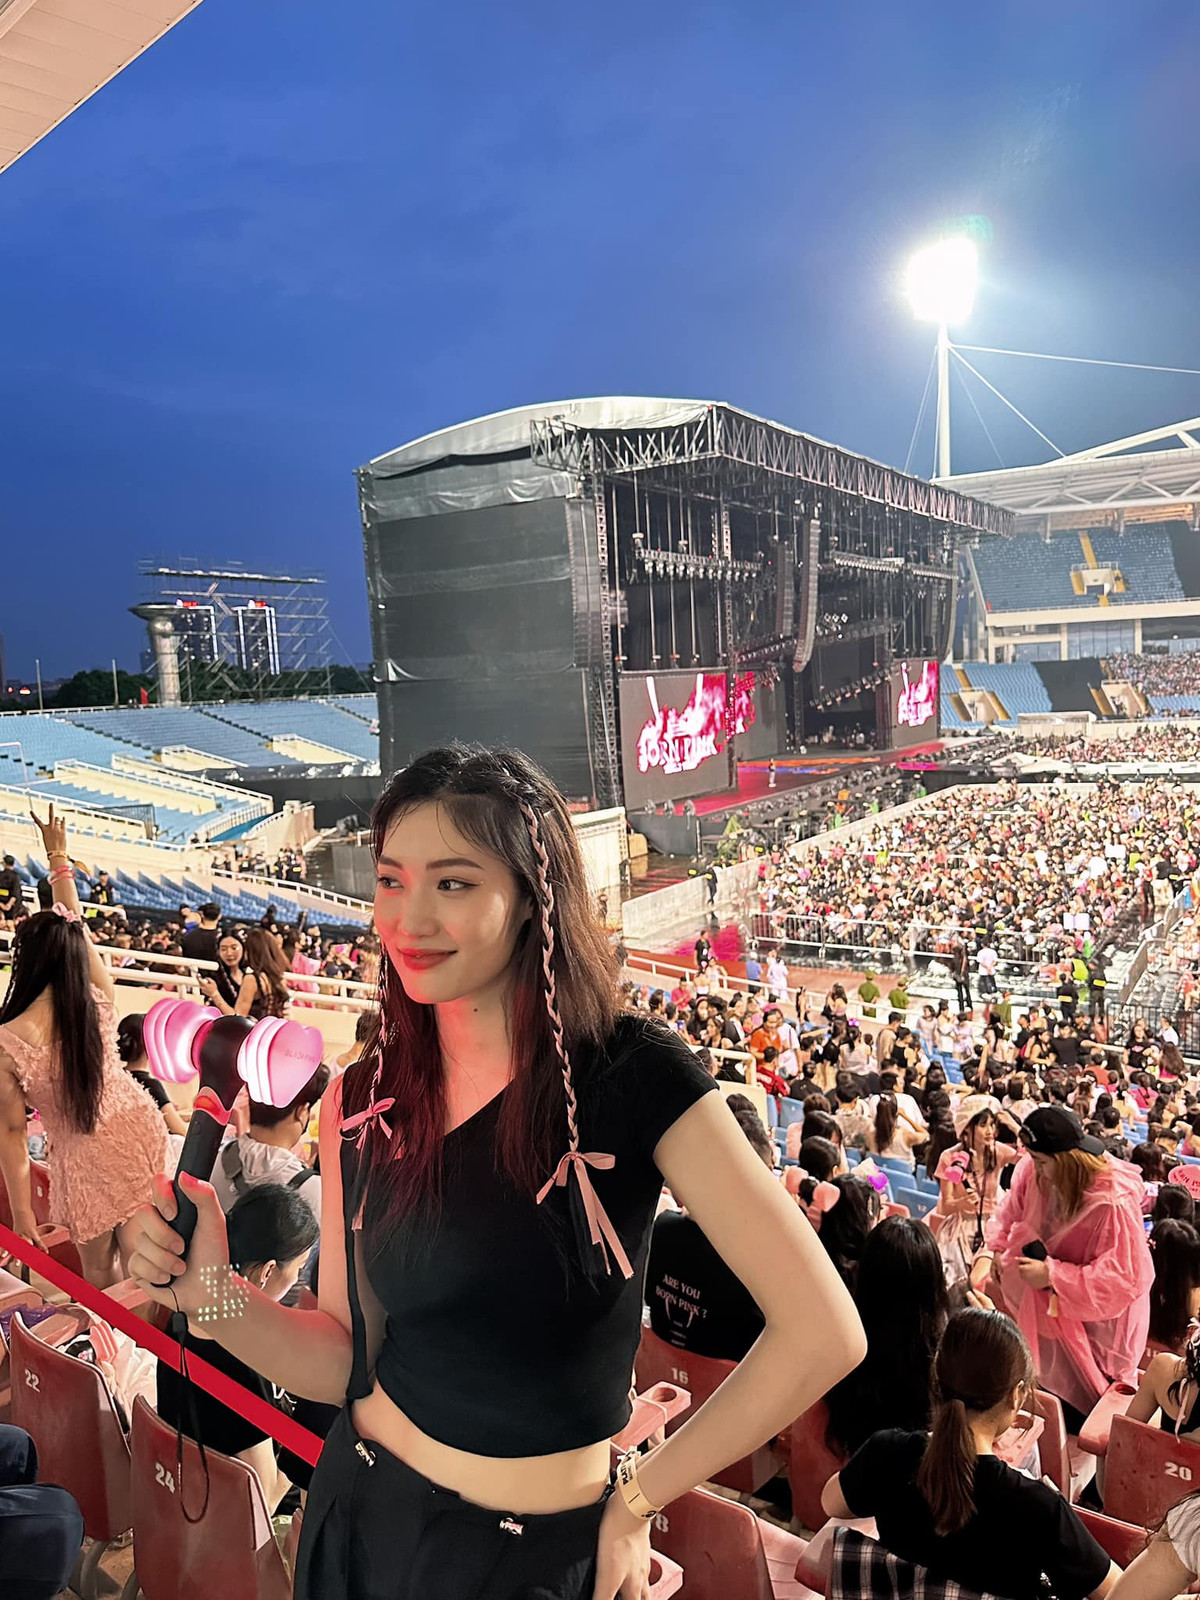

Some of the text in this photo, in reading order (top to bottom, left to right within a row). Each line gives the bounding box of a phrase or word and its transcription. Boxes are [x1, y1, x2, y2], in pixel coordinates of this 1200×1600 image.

[662, 1273, 701, 1300] ARE YOU
[655, 1285, 677, 1305] BORN
[678, 1298, 701, 1316] PINK
[24, 1368, 41, 1393] 22
[671, 1367, 689, 1385] 16
[155, 1463, 176, 1494] 24
[1164, 1461, 1192, 1481] 20
